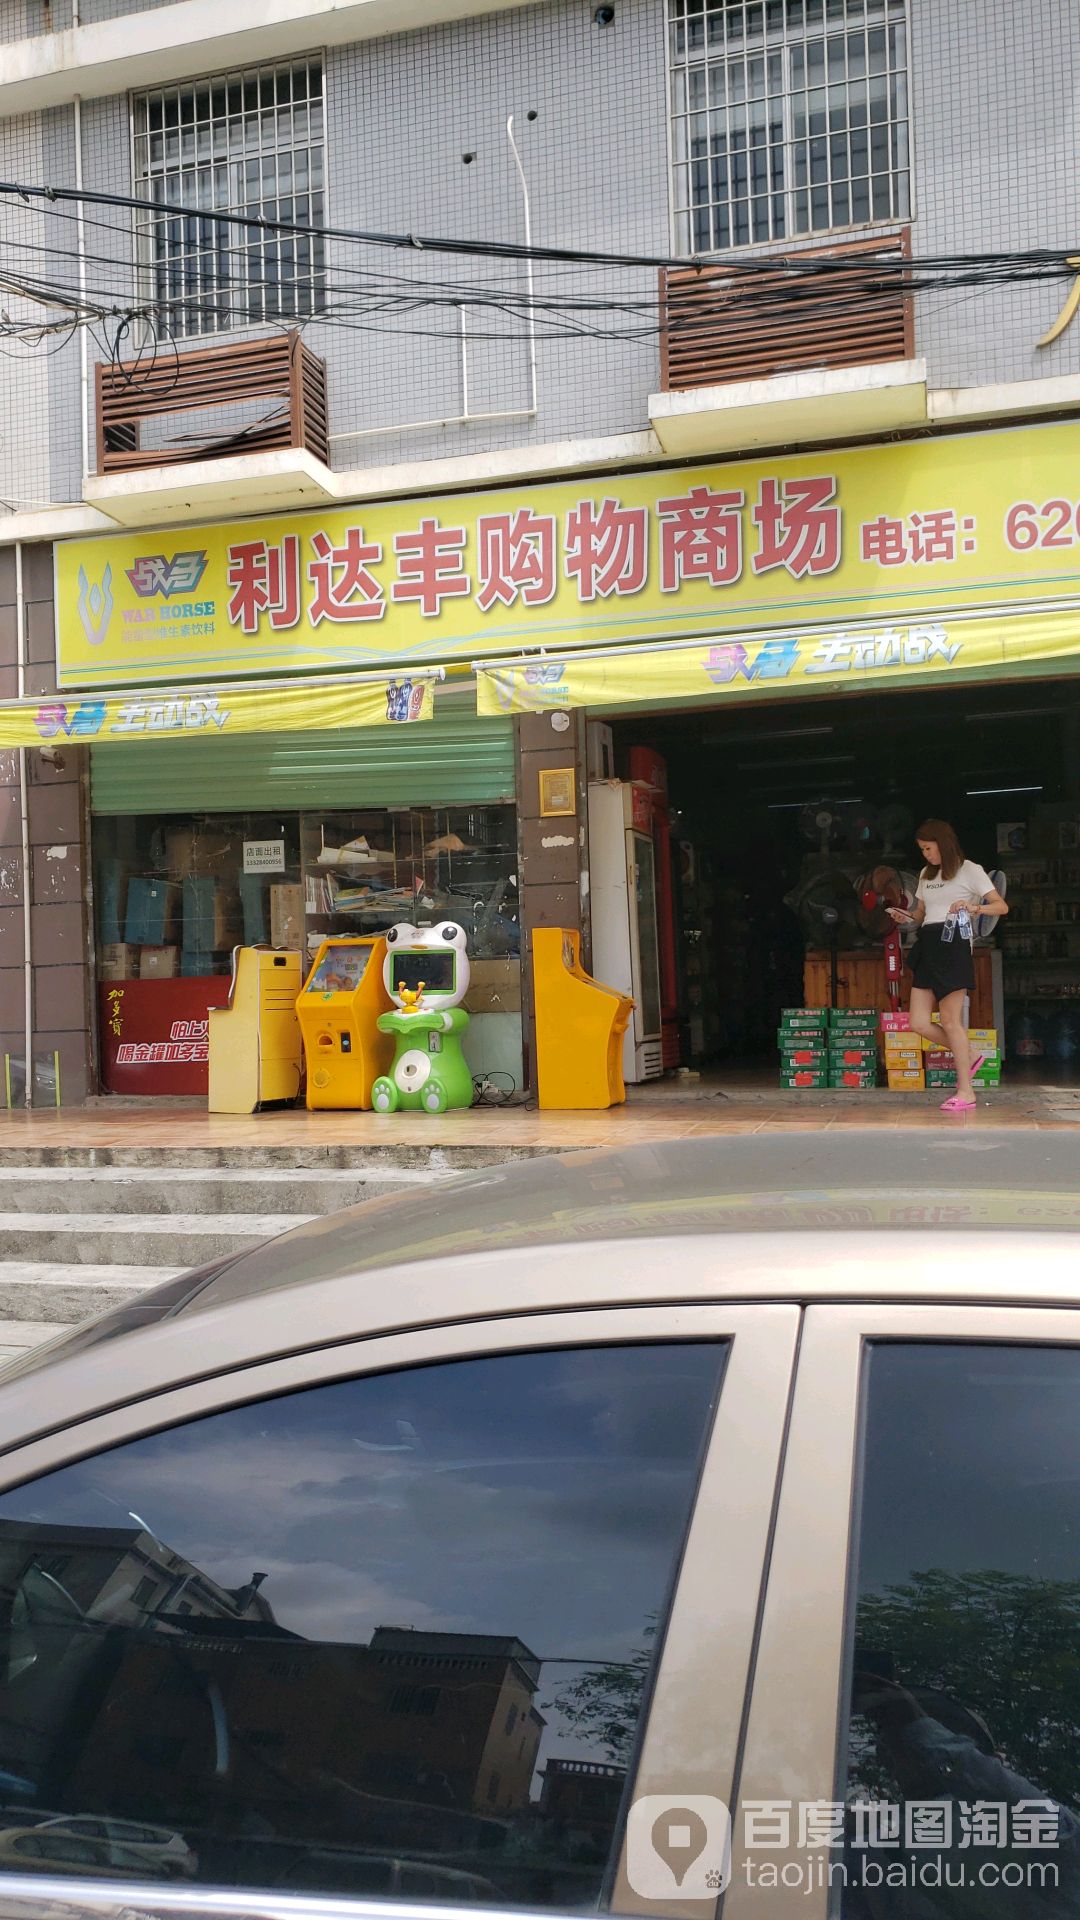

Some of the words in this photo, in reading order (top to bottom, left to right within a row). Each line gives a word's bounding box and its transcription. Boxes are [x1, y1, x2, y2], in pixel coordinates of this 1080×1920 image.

[1005, 500, 1080, 550] 62
[229, 477, 841, 632] 利达丰购物商场
[122, 608, 155, 623] WAR
[160, 601, 215, 620] HORSE
[805, 624, 964, 676] 主动战
[246, 846, 281, 857] 店面出租
[116, 1042, 209, 1064] 喝金罐加多宝
